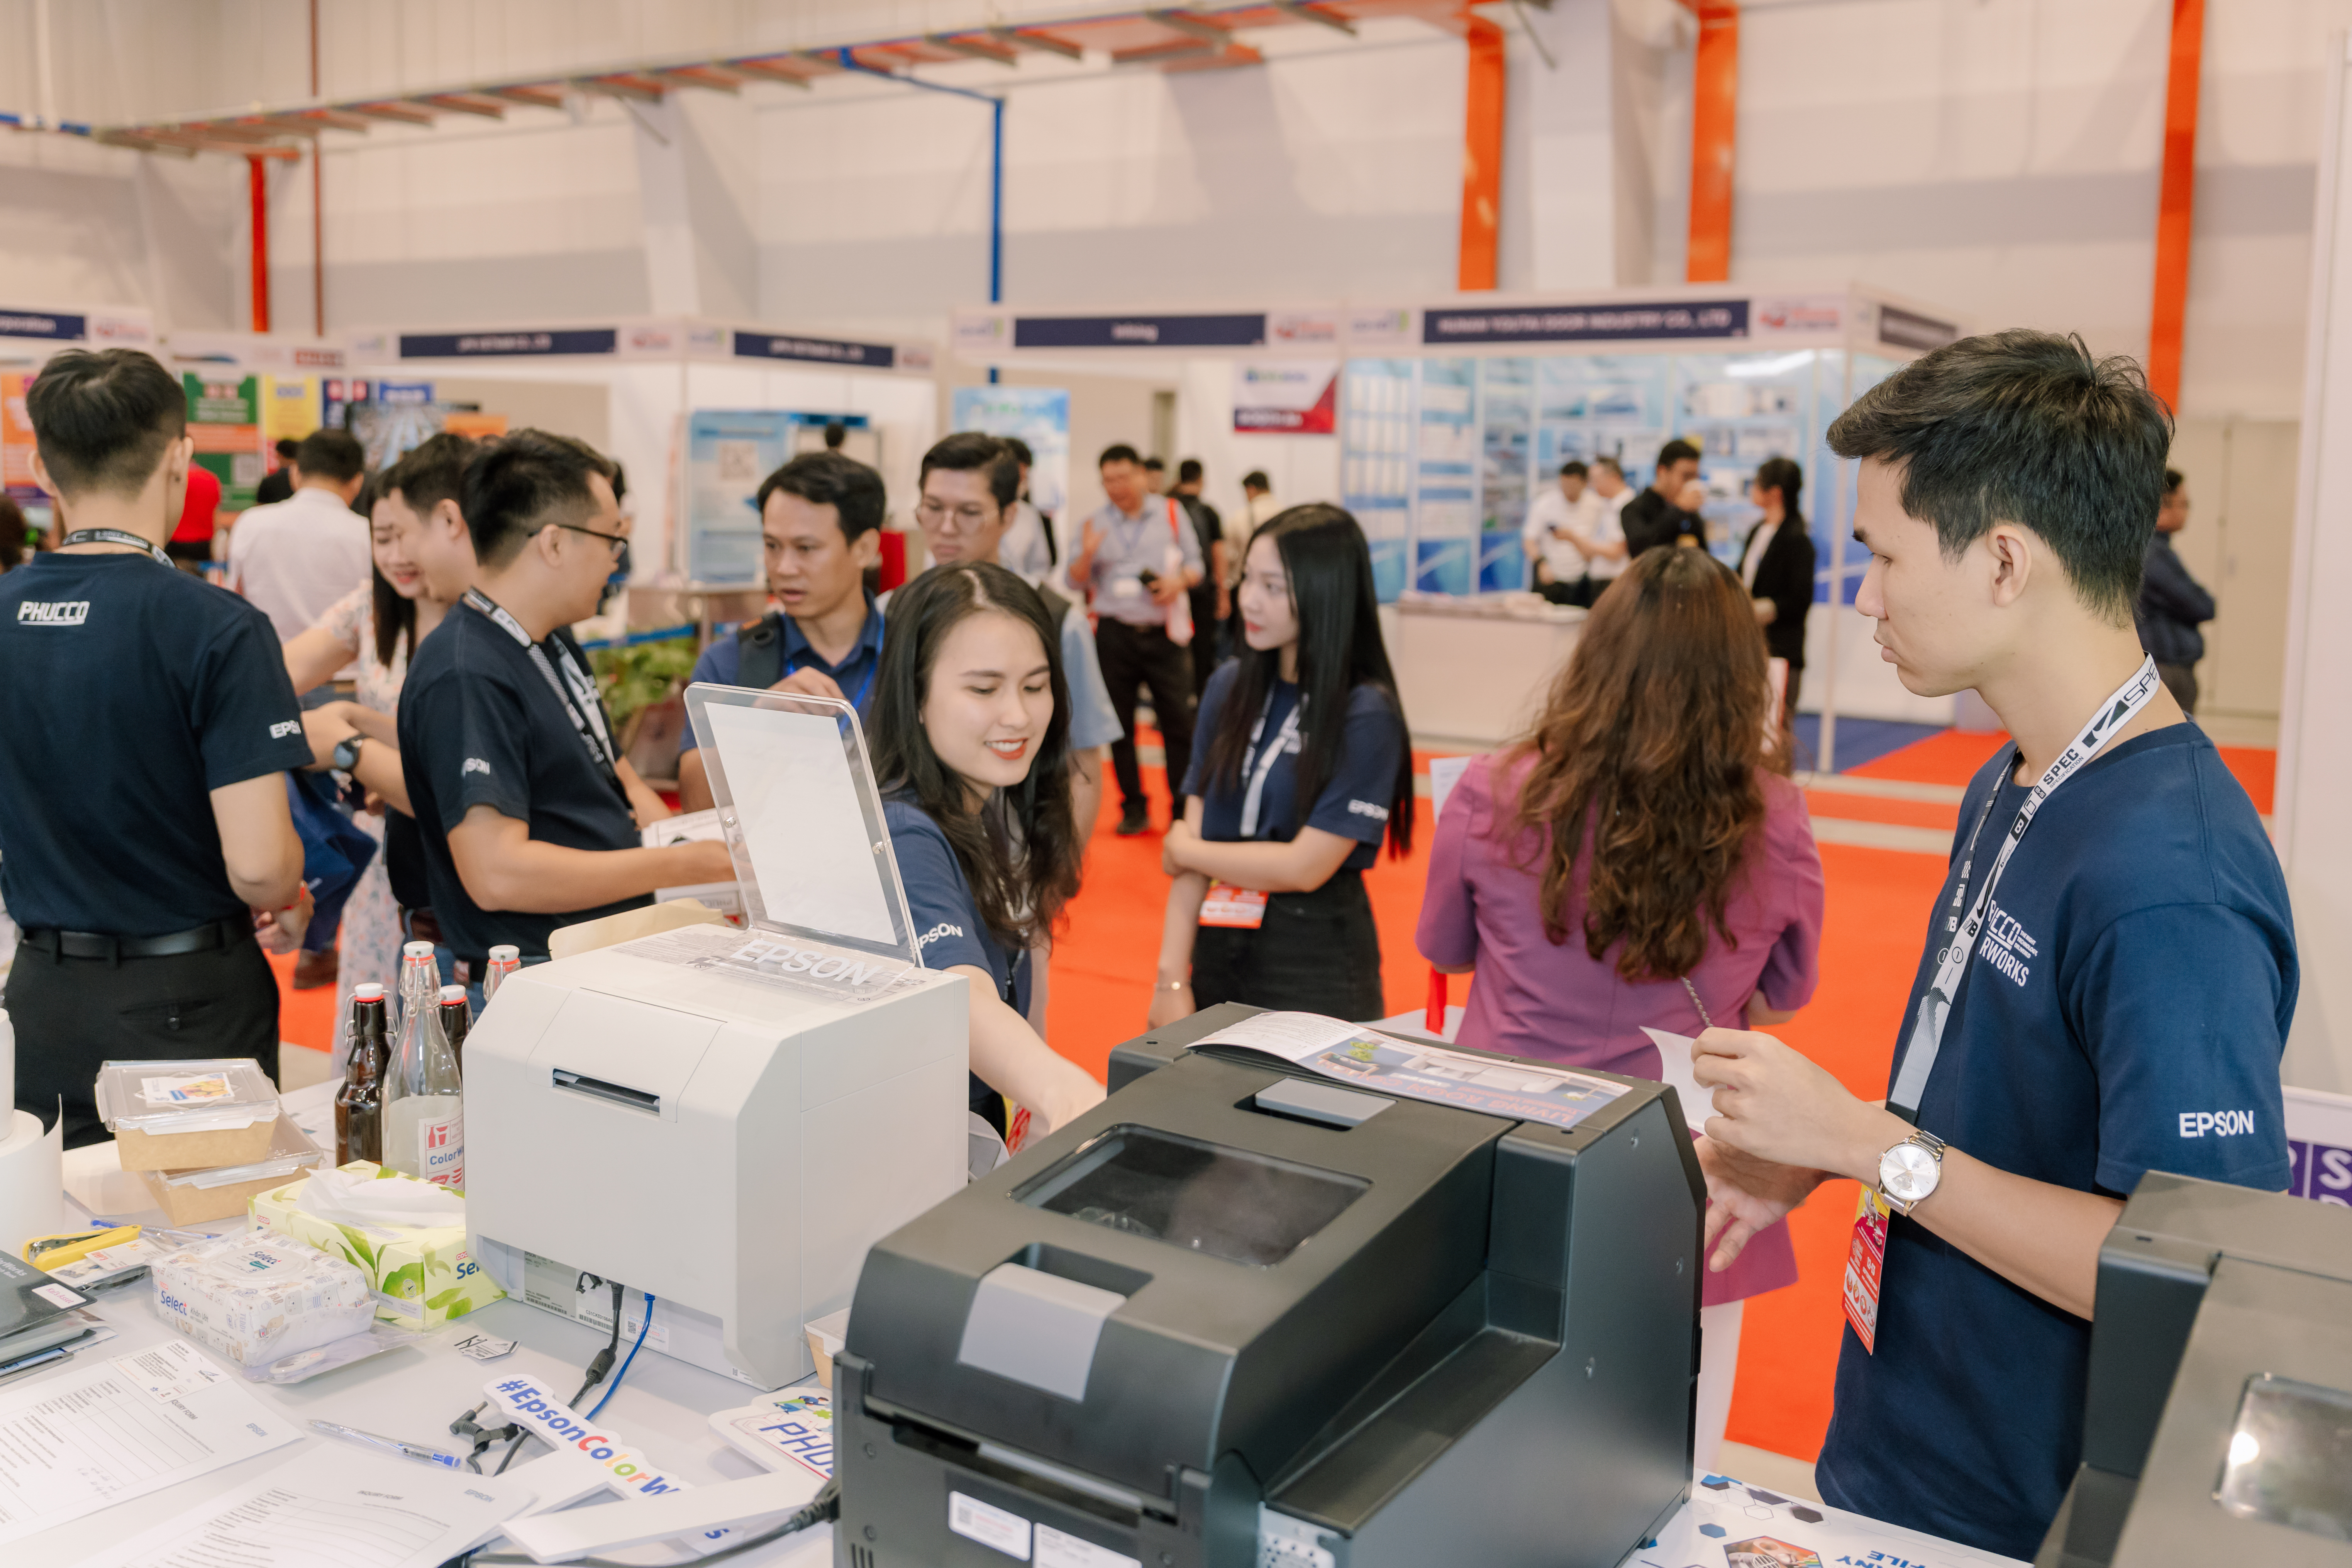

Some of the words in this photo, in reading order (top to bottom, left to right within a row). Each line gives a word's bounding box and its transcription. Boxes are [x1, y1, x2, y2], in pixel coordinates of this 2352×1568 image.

[17, 601, 90, 622] PHUCCO
[2043, 748, 2079, 785] SPEC
[2049, 756, 2084, 789] SPECIFICATION
[730, 939, 883, 987] EPSON
[1406, 1083, 1484, 1104] ROOM
[1488, 1100, 1575, 1123] LIVING
[2179, 1110, 2255, 1138] EPSON
[257, 1215, 270, 1225] COOP
[249, 1251, 282, 1265] Select
[160, 1290, 187, 1316] Select
[245, 1422, 269, 1437] EPSON
[759, 1422, 833, 1480] PHU
[464, 1488, 496, 1503] EPSON
